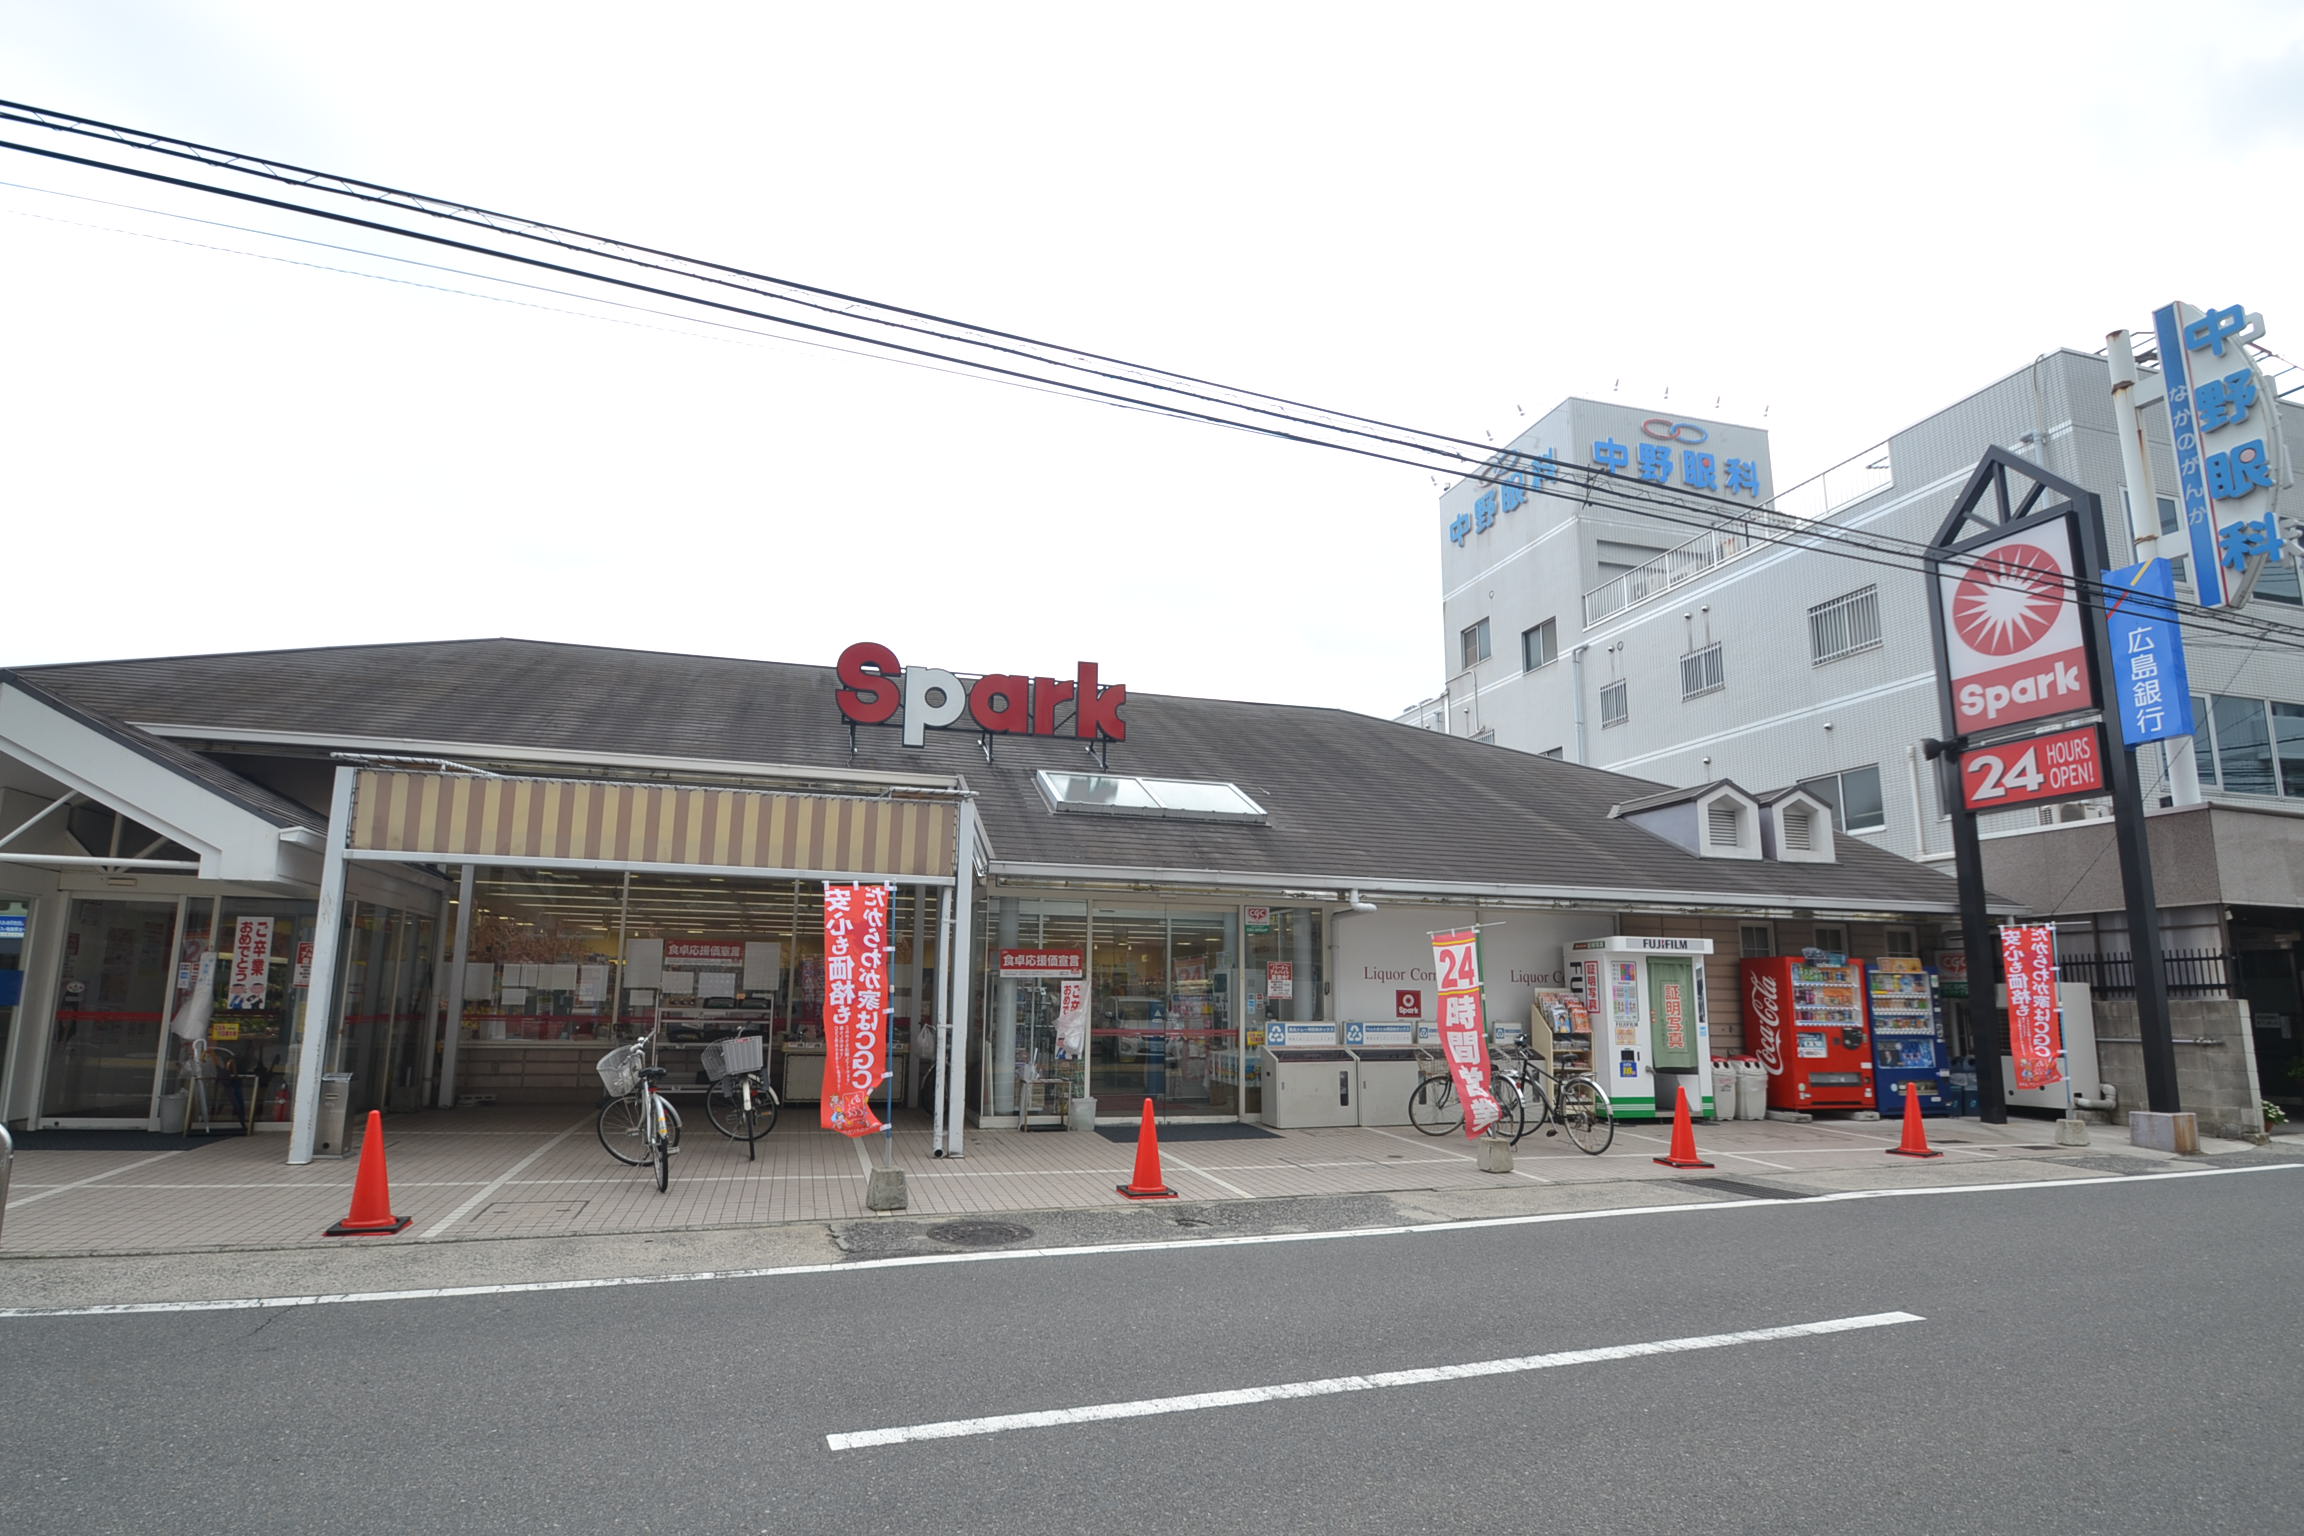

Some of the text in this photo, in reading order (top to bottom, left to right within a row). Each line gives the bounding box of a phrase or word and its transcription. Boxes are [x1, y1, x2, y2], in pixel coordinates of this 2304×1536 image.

[1593, 436, 1760, 497] 中野眼科
[2169, 384, 2207, 526] なかのがんか
[2184, 304, 2287, 572] 中野眼科
[1449, 448, 1558, 548] 中野眼科
[835, 641, 1126, 749] Spark
[1959, 661, 2081, 719] Spark
[2127, 626, 2166, 734] 広島銀行
[1967, 737, 2091, 801] 24 HOURS
[2049, 761, 2096, 790] OPEN!
[235, 921, 254, 982] おめでとう
[250, 921, 269, 977] ご卒業
[1003, 954, 1081, 967] 食卓応援価宣言
[1439, 945, 1476, 989] 24
[1642, 938, 1688, 950] FUJIFILM
[1364, 966, 1406, 984] Liquor
[1511, 969, 1549, 986] Liquor
[1586, 964, 1598, 1010] 証明写真
[1398, 1006, 1419, 1015] Spark
[1664, 985, 1685, 1048] 証明写真
[1446, 994, 1501, 1133] 時間営業
